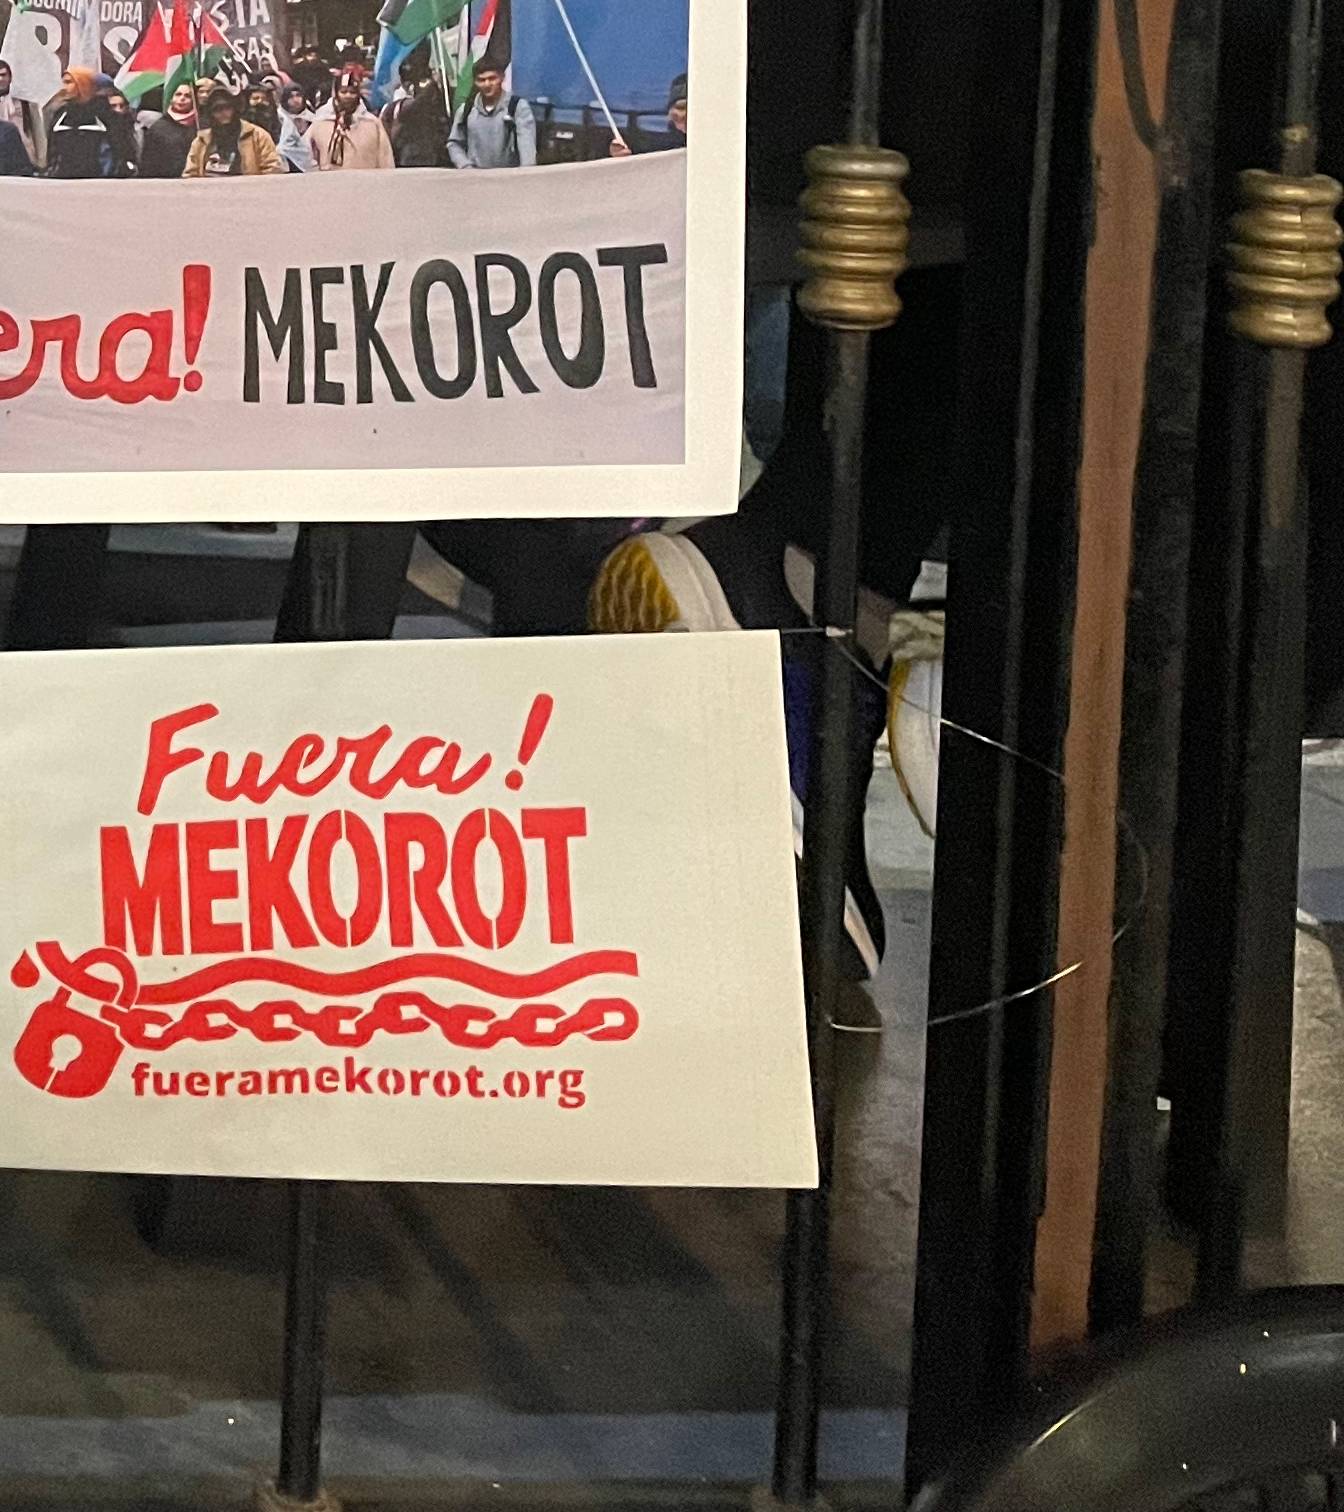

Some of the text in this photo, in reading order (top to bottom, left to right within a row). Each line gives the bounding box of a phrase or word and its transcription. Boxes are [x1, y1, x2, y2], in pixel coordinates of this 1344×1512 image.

[242, 242, 669, 405] MEKOROT
[98, 805, 588, 958] MEKOROT
[130, 1057, 587, 1111] fueramekorot.org
